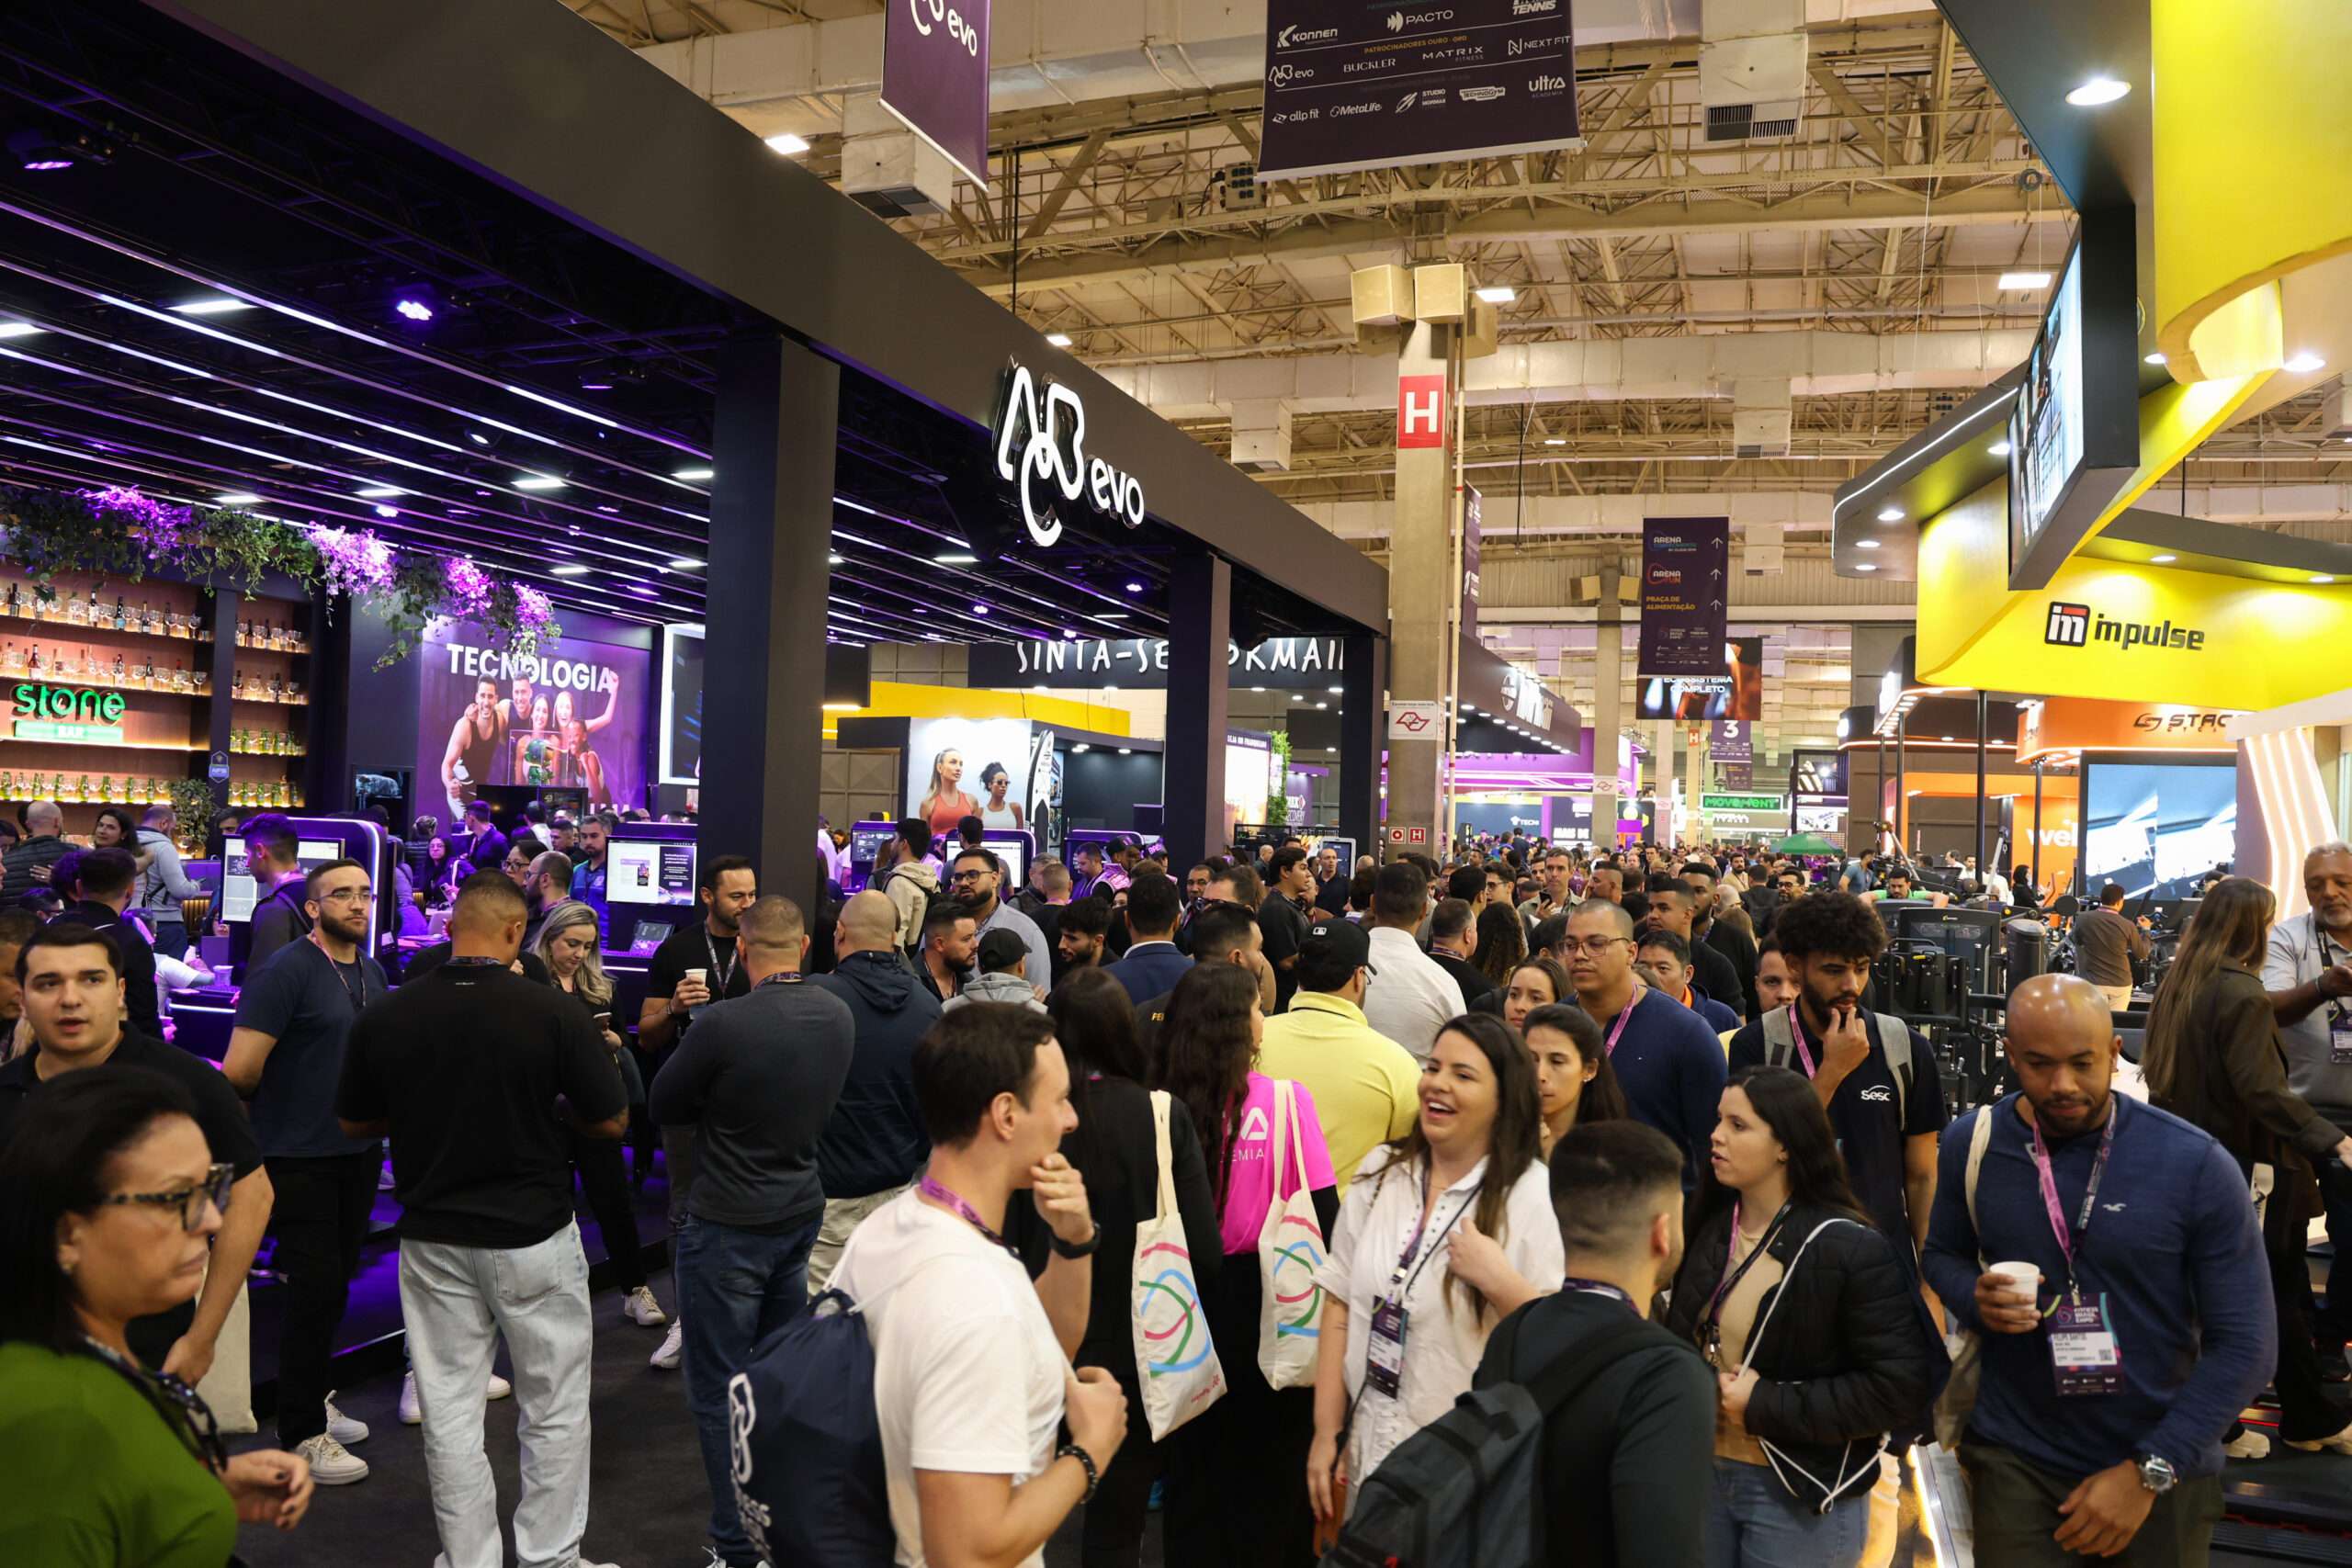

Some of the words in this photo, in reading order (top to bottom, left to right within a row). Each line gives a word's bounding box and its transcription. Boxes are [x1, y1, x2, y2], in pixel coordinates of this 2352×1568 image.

[1513, 1, 1555, 15] TENNIS
[1406, 10, 1453, 25] PACTO
[947, 8, 978, 56] evo
[1364, 39, 1427, 54] PATROCINADORES
[1524, 39, 1552, 50] NEXT
[1555, 36, 1571, 46] FIT
[1422, 46, 1484, 60] MATRIX
[1343, 58, 1396, 73] BUCKLER
[1295, 69, 1314, 79] evo
[1422, 88, 1446, 96] STUDIO
[1405, 390, 1438, 434] H
[1091, 457, 1145, 525] evo
[2095, 613, 2205, 650] impulse
[447, 643, 615, 694] TECNOLOGIA
[1670, 685, 1725, 694] COMPLETO
[16, 684, 126, 721] stone
[1724, 720, 1739, 739] 3
[1689, 733, 1698, 743] H
